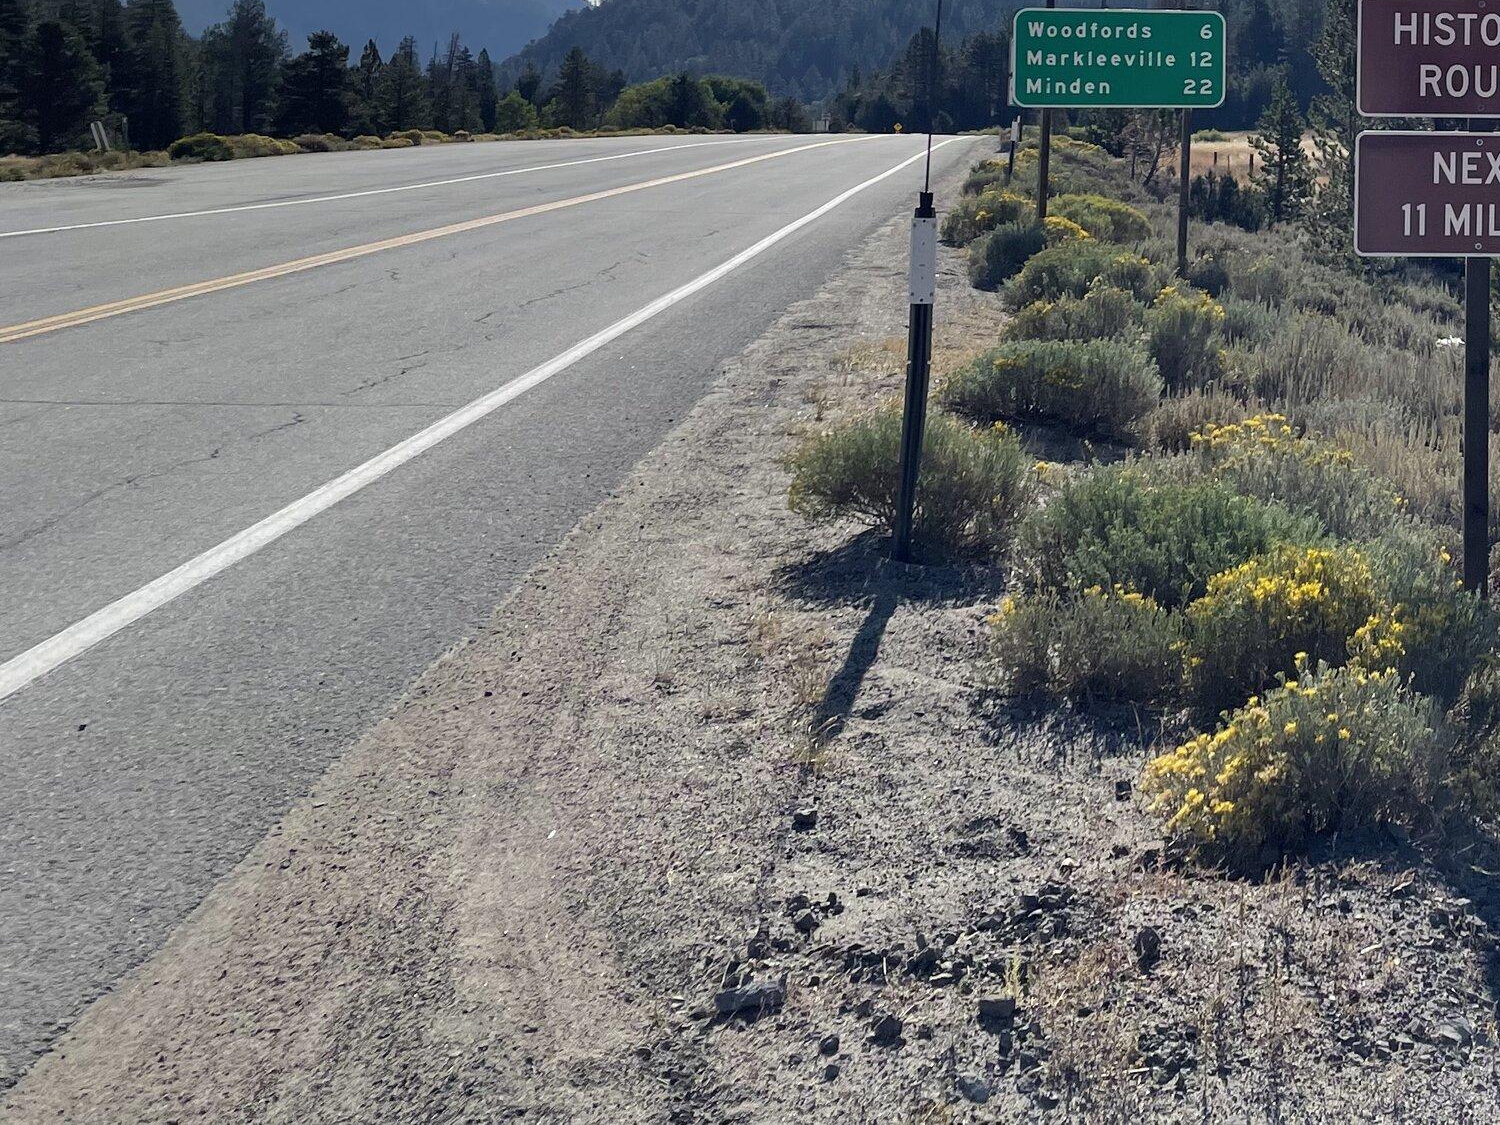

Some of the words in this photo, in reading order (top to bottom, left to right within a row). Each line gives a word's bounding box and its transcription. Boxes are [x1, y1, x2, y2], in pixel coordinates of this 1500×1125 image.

[1027, 21, 1152, 39] Woodfords
[1200, 24, 1213, 40] 6
[1026, 50, 1176, 67] Markleeville
[1190, 51, 1213, 67] 12
[1026, 78, 1110, 94] Minden
[1183, 78, 1213, 95] 22
[1401, 203, 1426, 236] 11
